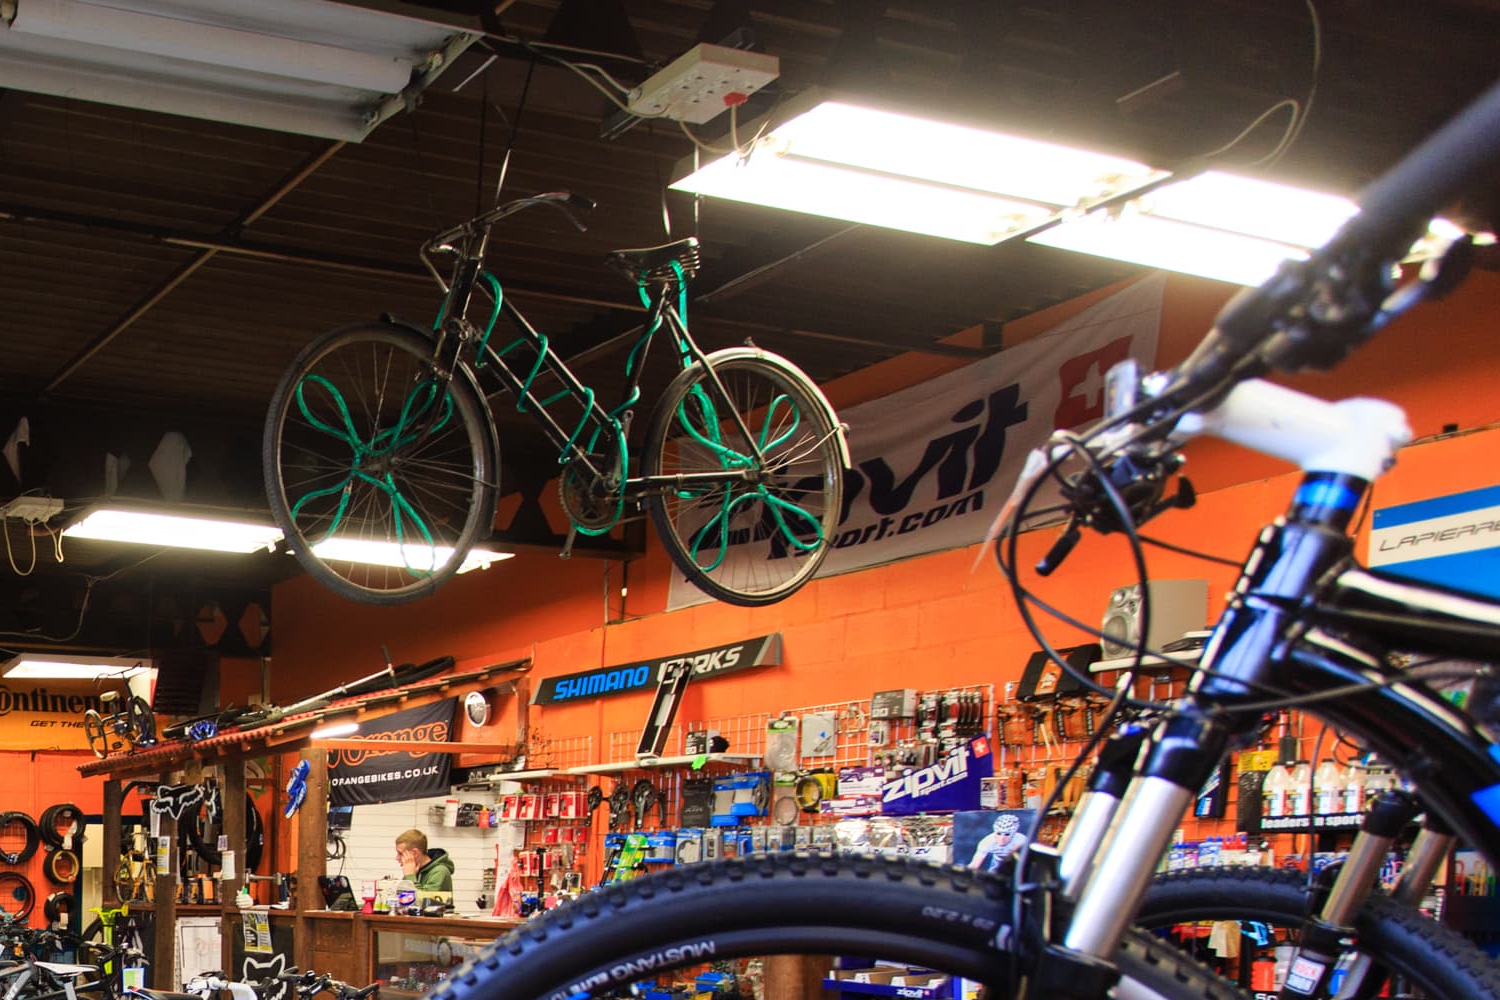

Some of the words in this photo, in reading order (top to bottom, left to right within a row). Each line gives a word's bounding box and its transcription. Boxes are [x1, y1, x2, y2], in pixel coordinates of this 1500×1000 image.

[552, 665, 650, 701] SHIMANO
[656, 645, 745, 685] WRKS
[30, 719, 56, 728] GET
[58, 720, 86, 729] THE
[331, 765, 440, 787] ORANGEBIKES.CO.UK
[882, 741, 971, 803] zipvit
[1260, 817, 1310, 829] leaders
[611, 939, 716, 981] MUSTANG
